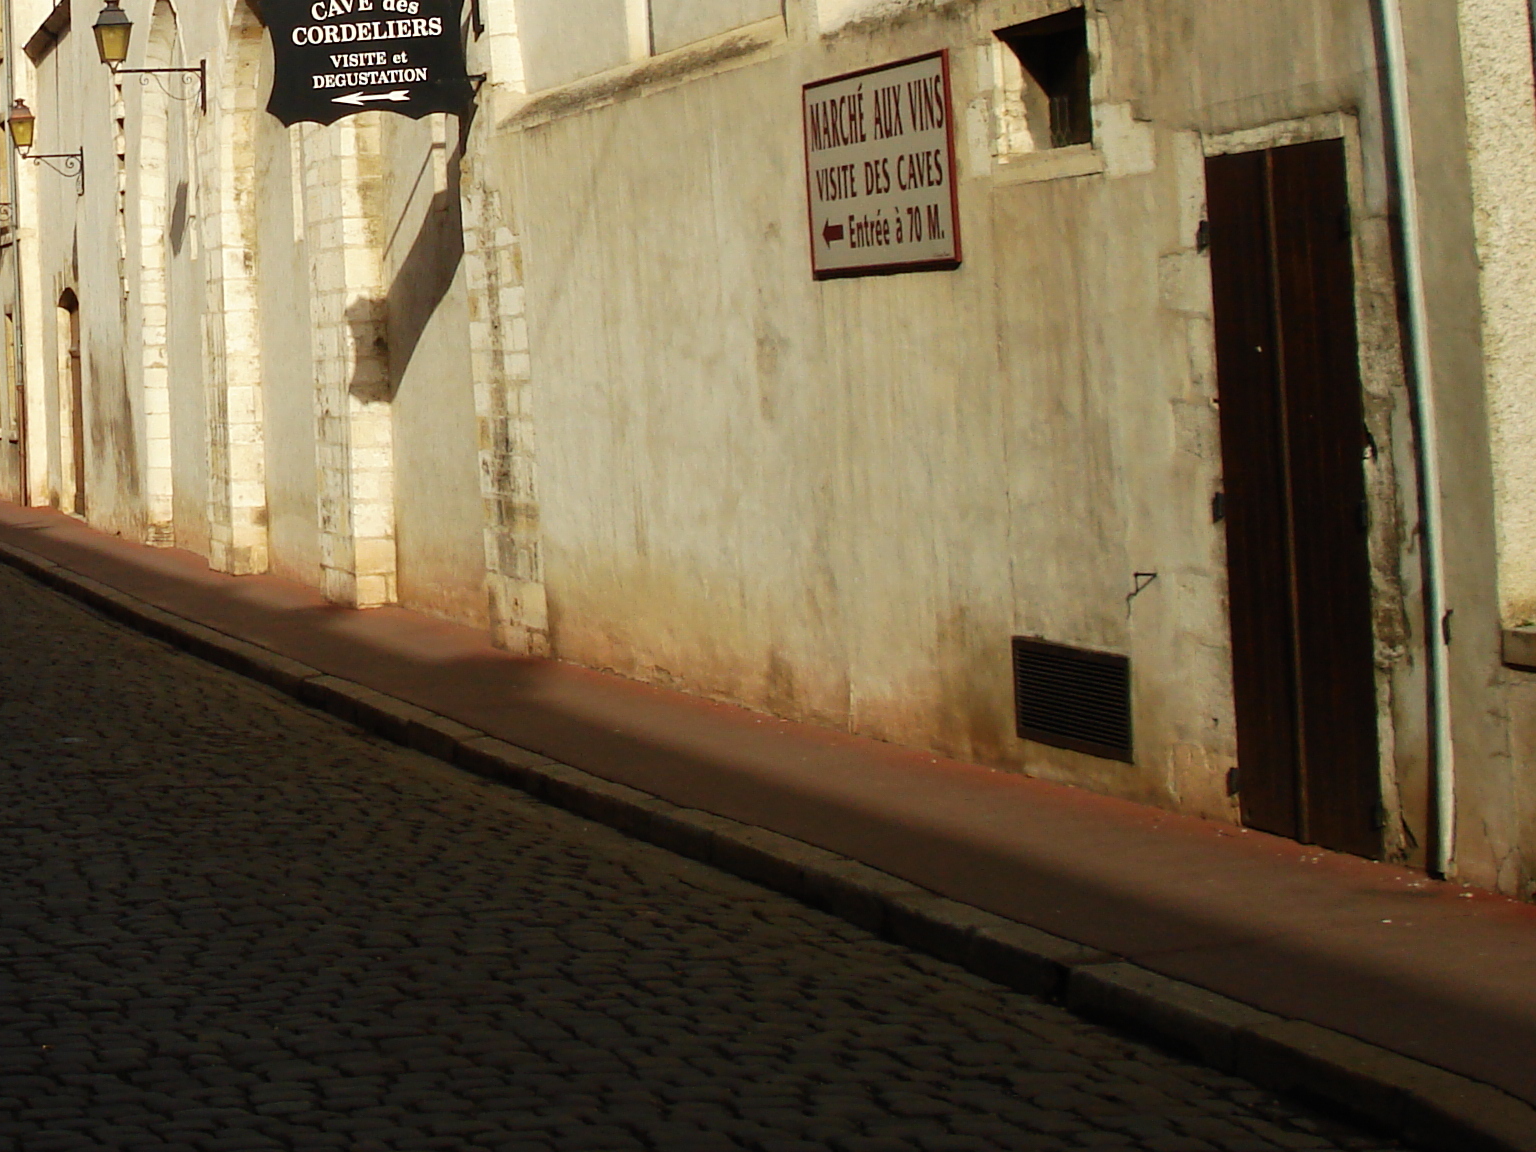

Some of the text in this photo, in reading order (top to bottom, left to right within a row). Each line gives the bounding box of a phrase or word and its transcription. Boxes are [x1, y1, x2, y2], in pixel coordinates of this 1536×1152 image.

[291, 16, 443, 46] CORDELIERS
[311, 67, 428, 90] DEGUSTATION
[329, 51, 408, 69] VISITE et
[810, 75, 944, 152] MARCHÉ AUX VINS
[816, 149, 943, 202] VISITE DES CAVES
[848, 204, 945, 249] Entrée à 70 M.
